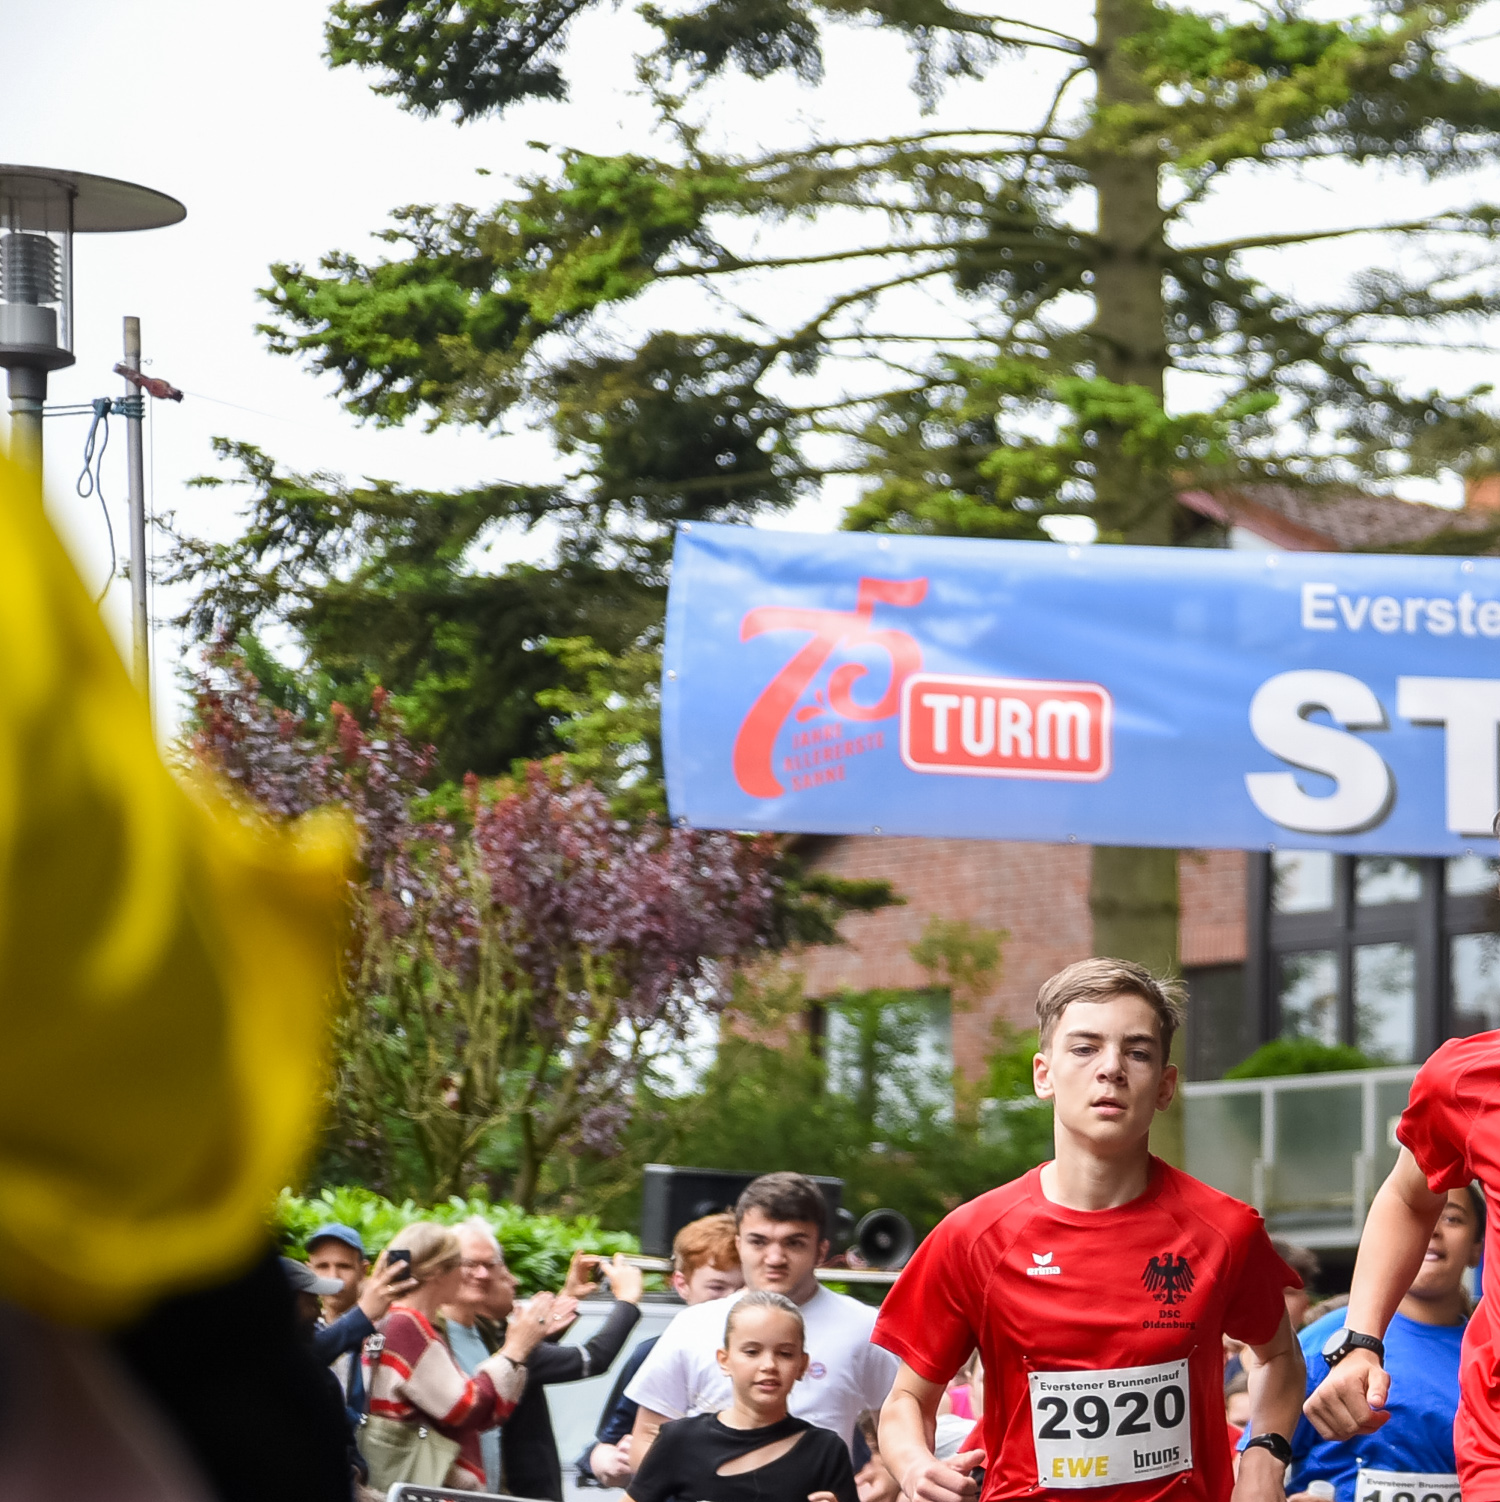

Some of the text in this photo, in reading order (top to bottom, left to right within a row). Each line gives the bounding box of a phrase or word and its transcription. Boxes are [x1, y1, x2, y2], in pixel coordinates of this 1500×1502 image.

[920, 692, 1091, 762] TURM
[1026, 1265, 1061, 1276] erima
[1142, 1320, 1196, 1330] Oldenburg
[1159, 1310, 1181, 1319] DSC
[1040, 1370, 1180, 1391] Everstener Brunnenlauf
[1036, 1385, 1186, 1440] 2920
[1052, 1455, 1110, 1478] EWE
[1133, 1445, 1180, 1469] bruns
